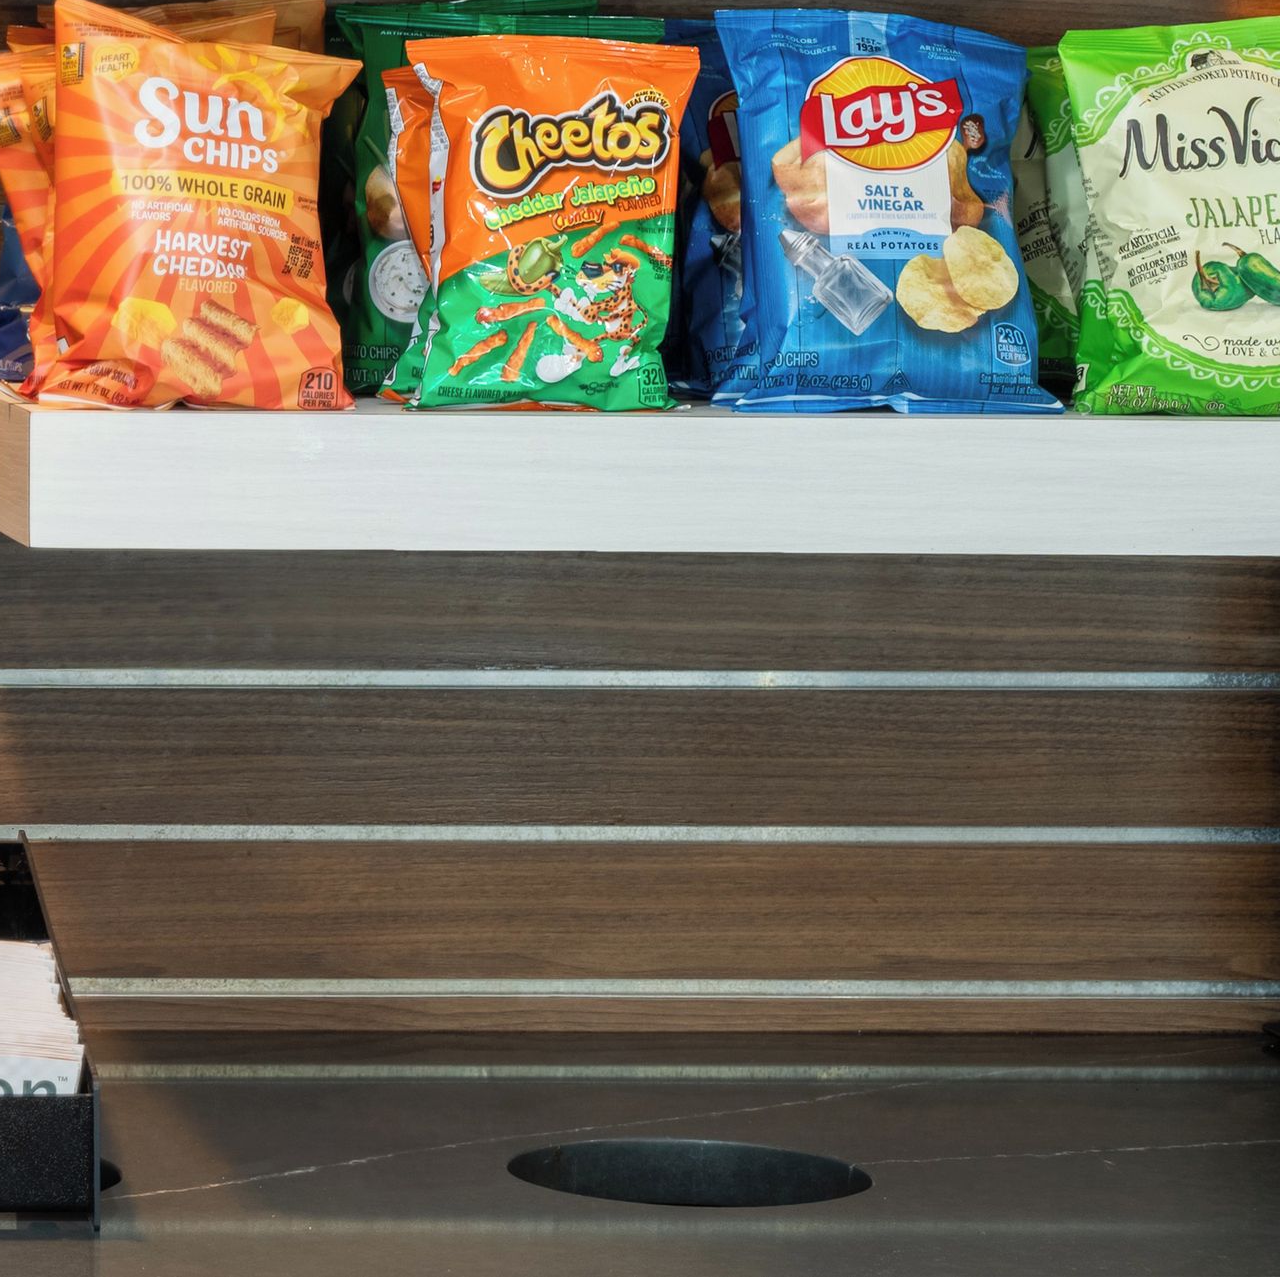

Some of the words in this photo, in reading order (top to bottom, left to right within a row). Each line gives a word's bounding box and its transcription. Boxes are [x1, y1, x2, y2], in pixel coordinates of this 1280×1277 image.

[101, 53, 130, 62] HEART
[799, 45, 837, 55] SOURCES
[95, 61, 135, 73] HEALTHY
[1187, 68, 1229, 87] COOKED
[1230, 68, 1269, 83] POTATO
[625, 97, 641, 109] REAL
[134, 77, 266, 148] Sun
[820, 82, 948, 146] Lay's
[480, 101, 661, 187] Cheetos
[1120, 113, 1225, 178] Miss
[183, 139, 279, 174] CHIPS
[122, 175, 172, 192] 100%
[177, 177, 238, 198] WHOLE
[243, 185, 286, 210] GRAIN
[865, 185, 898, 197] SALT
[902, 187, 914, 198] &
[147, 201, 194, 213] ARTIFICIAL
[485, 191, 564, 230] Cheddar
[571, 175, 656, 206] Jalapeño
[617, 195, 661, 212] FLAVORED
[858, 199, 924, 211] VINEGAR
[131, 211, 171, 222] FLAVORS
[217, 207, 230, 217] NO
[231, 209, 261, 223] COLORS
[262, 215, 281, 228] FROM
[552, 207, 604, 231] Crunchy
[217, 217, 257, 233] ARTIFICIAL
[257, 225, 288, 241] SOURCES
[872, 230, 890, 238] MADE
[893, 230, 910, 238] WITH
[153, 229, 251, 260] HARVEST
[847, 242, 876, 250] REAL
[881, 241, 939, 251] POTATOES
[1118, 245, 1129, 254] NO
[1129, 225, 1179, 250] ARTIFICIAL
[152, 255, 245, 279] CHEDDAR
[1127, 268, 1135, 279] NO
[1135, 258, 1165, 276] COLORS
[1166, 250, 1188, 263] FROM
[1129, 271, 1158, 287] ARTIFICIAL
[1160, 259, 1188, 273] SOURCES
[179, 278, 238, 294] FLAVORED
[998, 327, 1024, 345] 230
[1223, 337, 1262, 347] made
[370, 346, 399, 360] CHIPS
[998, 344, 1028, 355] CALORIES
[1225, 347, 1255, 357] LOVE
[1260, 347, 1267, 357] &
[785, 353, 818, 366] CHIPS
[305, 372, 333, 390] 210
[643, 368, 664, 385] 320
[765, 376, 784, 388] WT.
[811, 375, 830, 388] OZ.
[831, 374, 859, 389] (42.5
[861, 375, 871, 391] g)
[301, 390, 335, 400] CALORIES
[438, 385, 464, 398] CHEESE
[1111, 385, 1132, 397] NET
[1136, 387, 1156, 398] WT.
